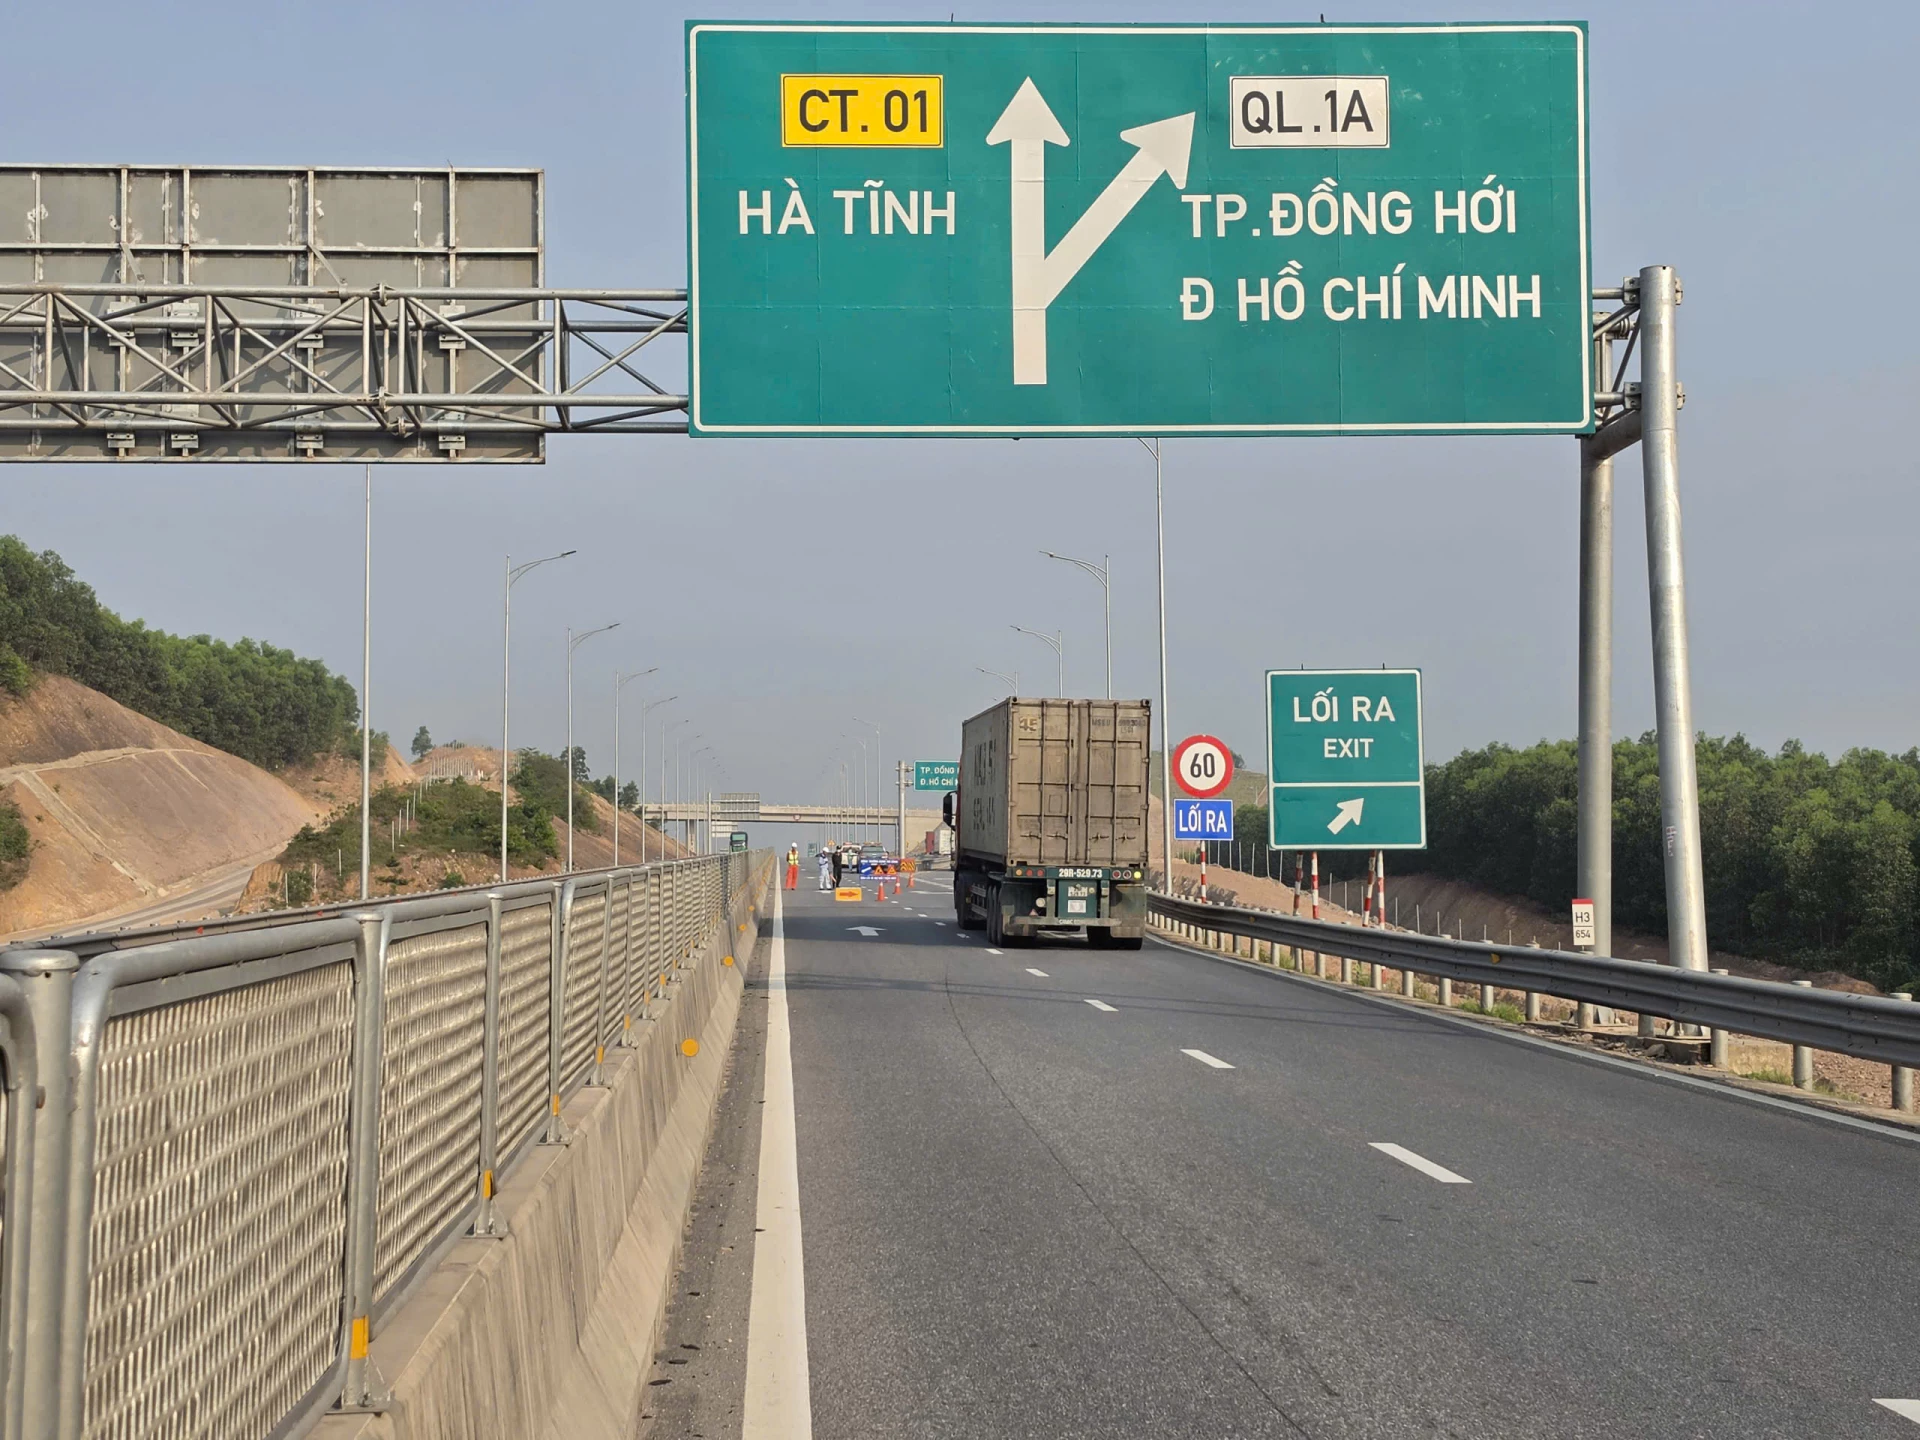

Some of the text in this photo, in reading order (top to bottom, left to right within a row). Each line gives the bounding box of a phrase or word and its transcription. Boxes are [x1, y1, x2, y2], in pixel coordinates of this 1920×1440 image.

[799, 89, 928, 133] CT. 01
[738, 178, 956, 235] HÀ TĨNH
[1435, 174, 1516, 234] HỚI
[1180, 260, 1541, 322] Đ HỒ CHÍ MINH
[1293, 687, 1396, 722] LỐI RA
[1324, 738, 1374, 758] EXIT
[1190, 752, 1216, 778] 60
[1178, 803, 1228, 832] LỐI RA
[1575, 912, 1590, 922] H3
[1576, 930, 1591, 938] 654
